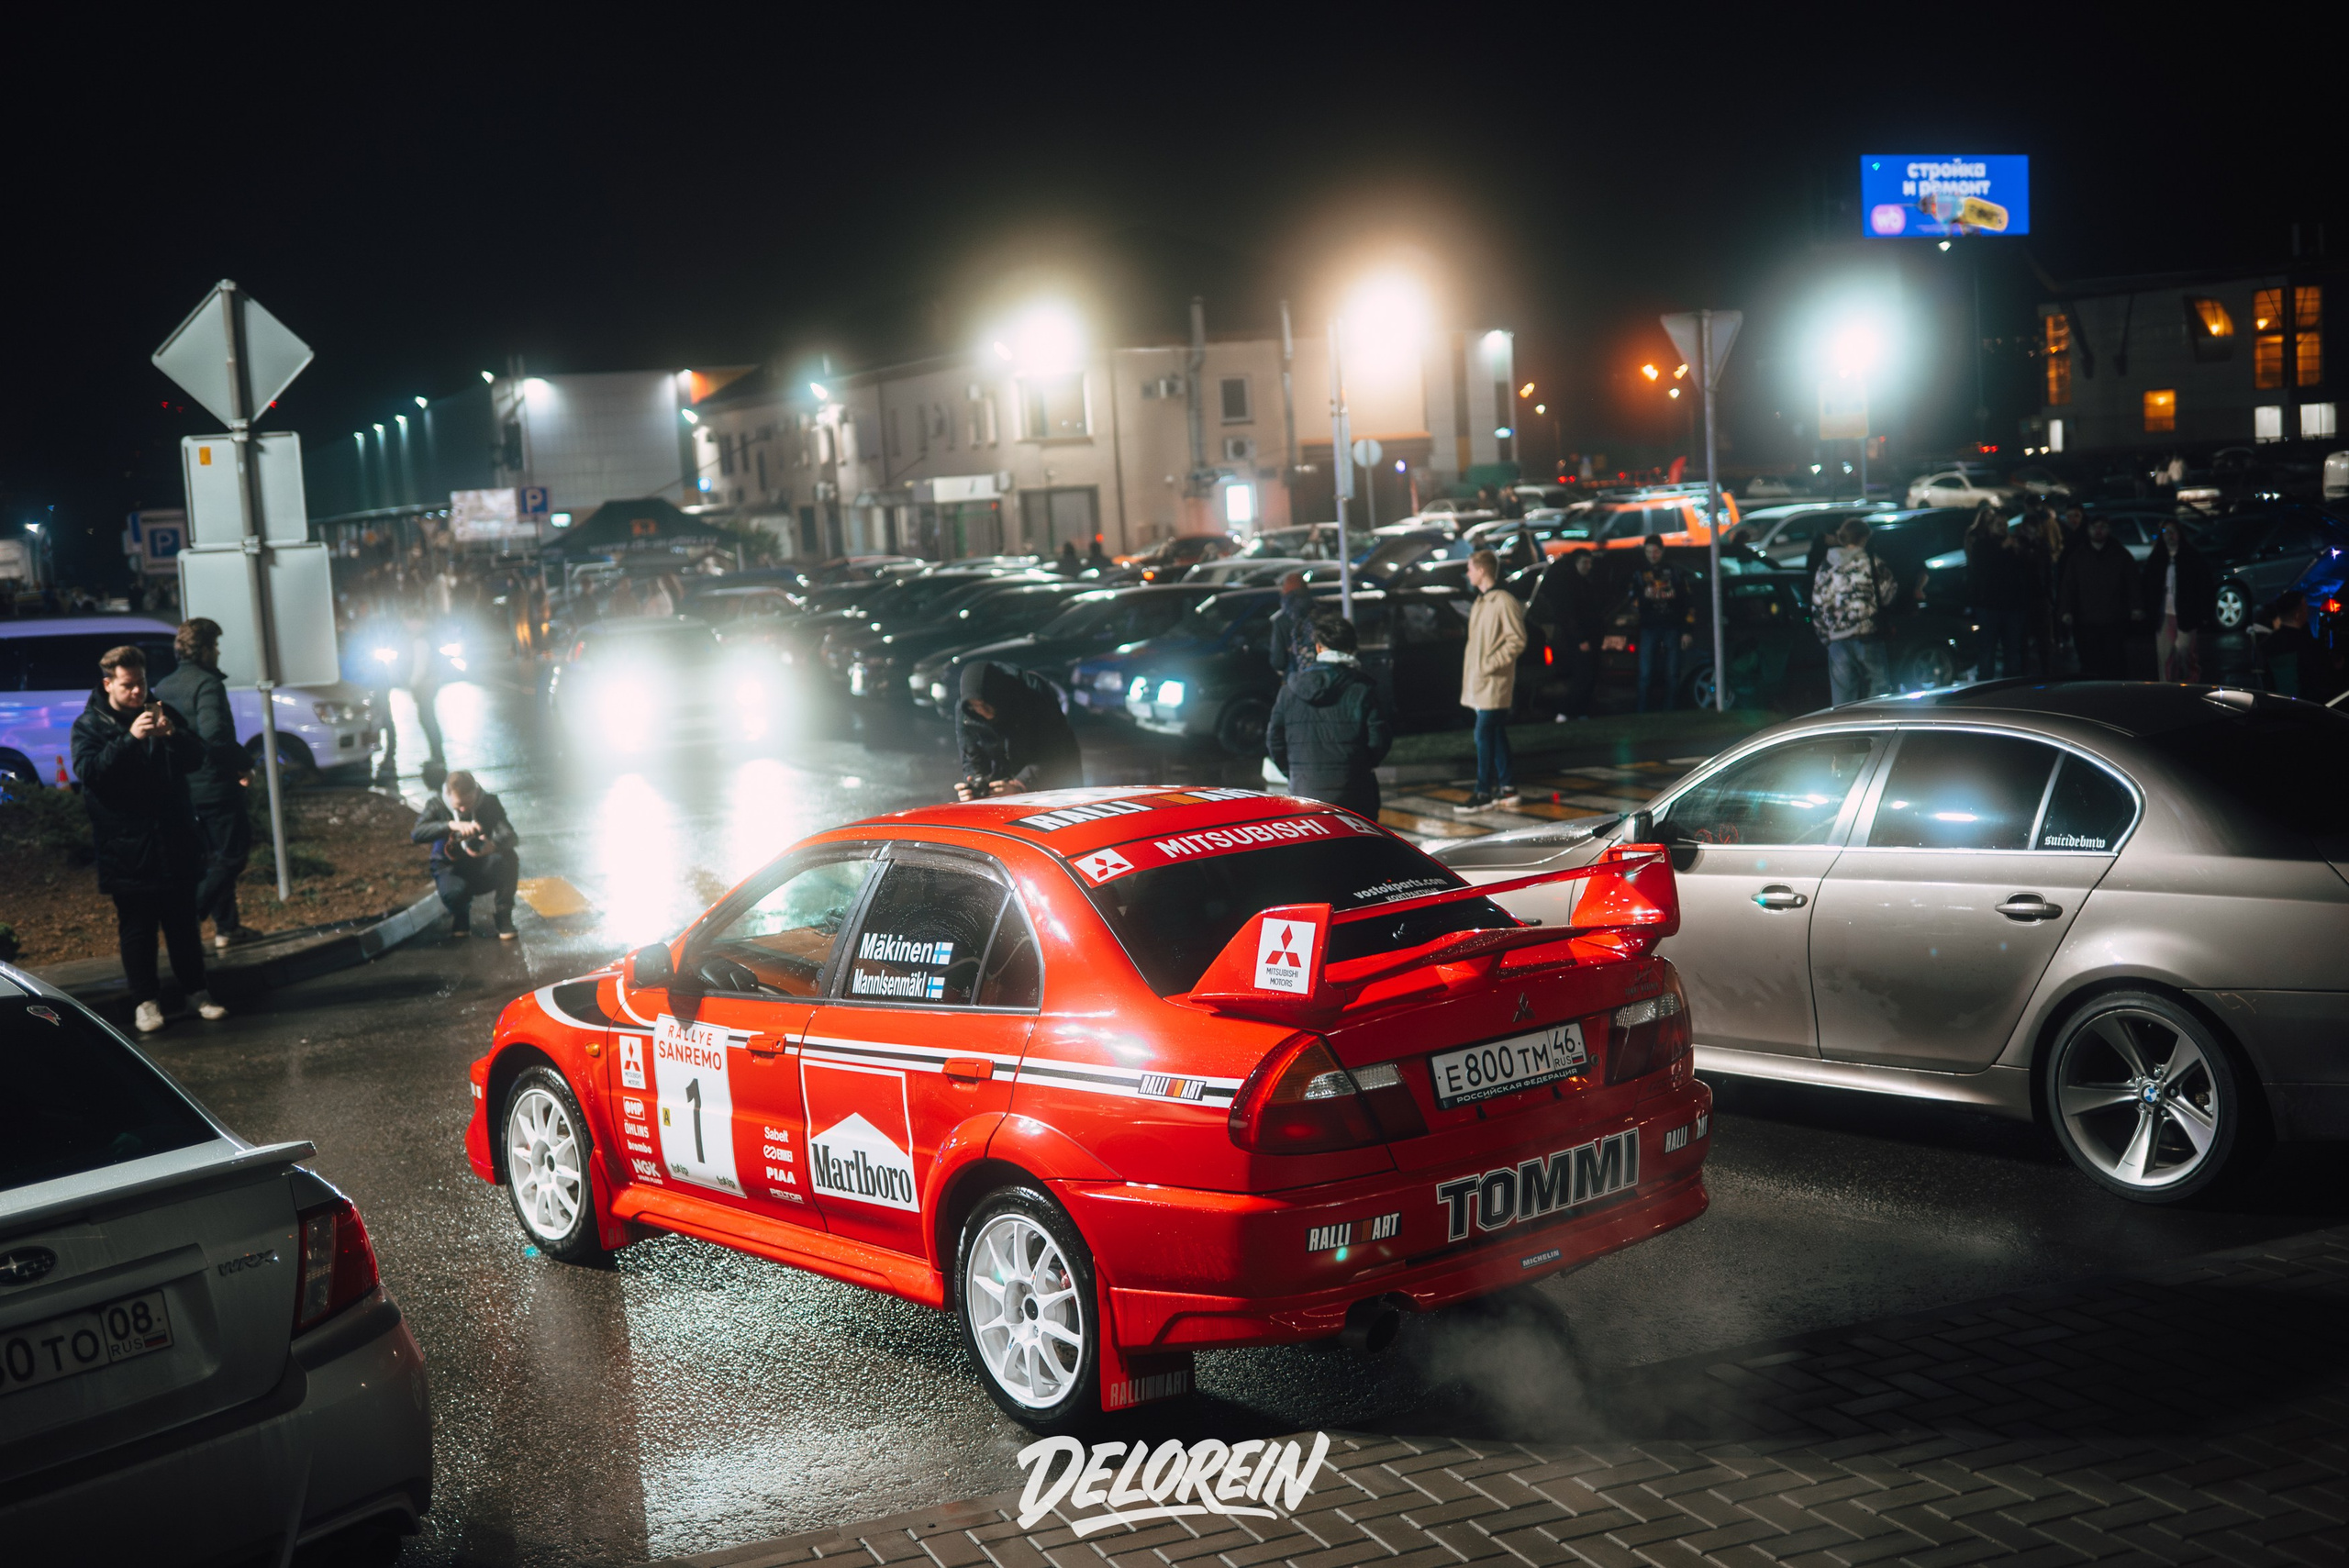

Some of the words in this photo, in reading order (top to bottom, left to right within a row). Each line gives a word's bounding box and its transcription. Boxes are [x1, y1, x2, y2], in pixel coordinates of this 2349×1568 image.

[1907, 158, 1987, 181] стройка
[1902, 181, 1916, 196] и
[1919, 180, 1991, 196] ремонт
[1019, 800, 1153, 831] RALLI
[1153, 818, 1330, 858] MITSUBISHI
[2043, 833, 2106, 849] suicidebmw
[1353, 878, 1448, 900] vostokparts.com
[858, 932, 934, 963] Mäkinen
[1265, 967, 1299, 978] MITSUBISHI
[1269, 977, 1294, 988] MOTORS
[667, 1024, 713, 1047] RALLYE
[1553, 1028, 1576, 1056] 46
[658, 1040, 722, 1071] SANREMO
[1554, 1055, 1572, 1067] RUS
[1139, 1075, 1171, 1096] RALLI
[1180, 1080, 1206, 1100] ART
[1456, 1083, 1523, 1104] РОССИЙСКАЯ
[1523, 1067, 1578, 1086] ФЕДЕРАЦИЯ
[624, 1118, 650, 1139] ÖHLINS
[663, 1109, 671, 1125] A
[685, 1077, 706, 1164] 1
[763, 1126, 789, 1143] Sabelt
[1664, 1125, 1688, 1153] RALLI
[631, 1158, 662, 1178] NGK
[765, 1166, 796, 1184] PIAA
[812, 1143, 912, 1204] Marlboro
[769, 1187, 804, 1202] PELTOR
[1436, 1127, 1640, 1243] TOMMI
[1308, 1222, 1352, 1251] RALLI
[1372, 1212, 1400, 1240] ART
[217, 1248, 279, 1277] WRX
[1522, 1249, 1560, 1267] MICHELIN
[107, 1301, 153, 1340] 08
[111, 1338, 144, 1357] RUS
